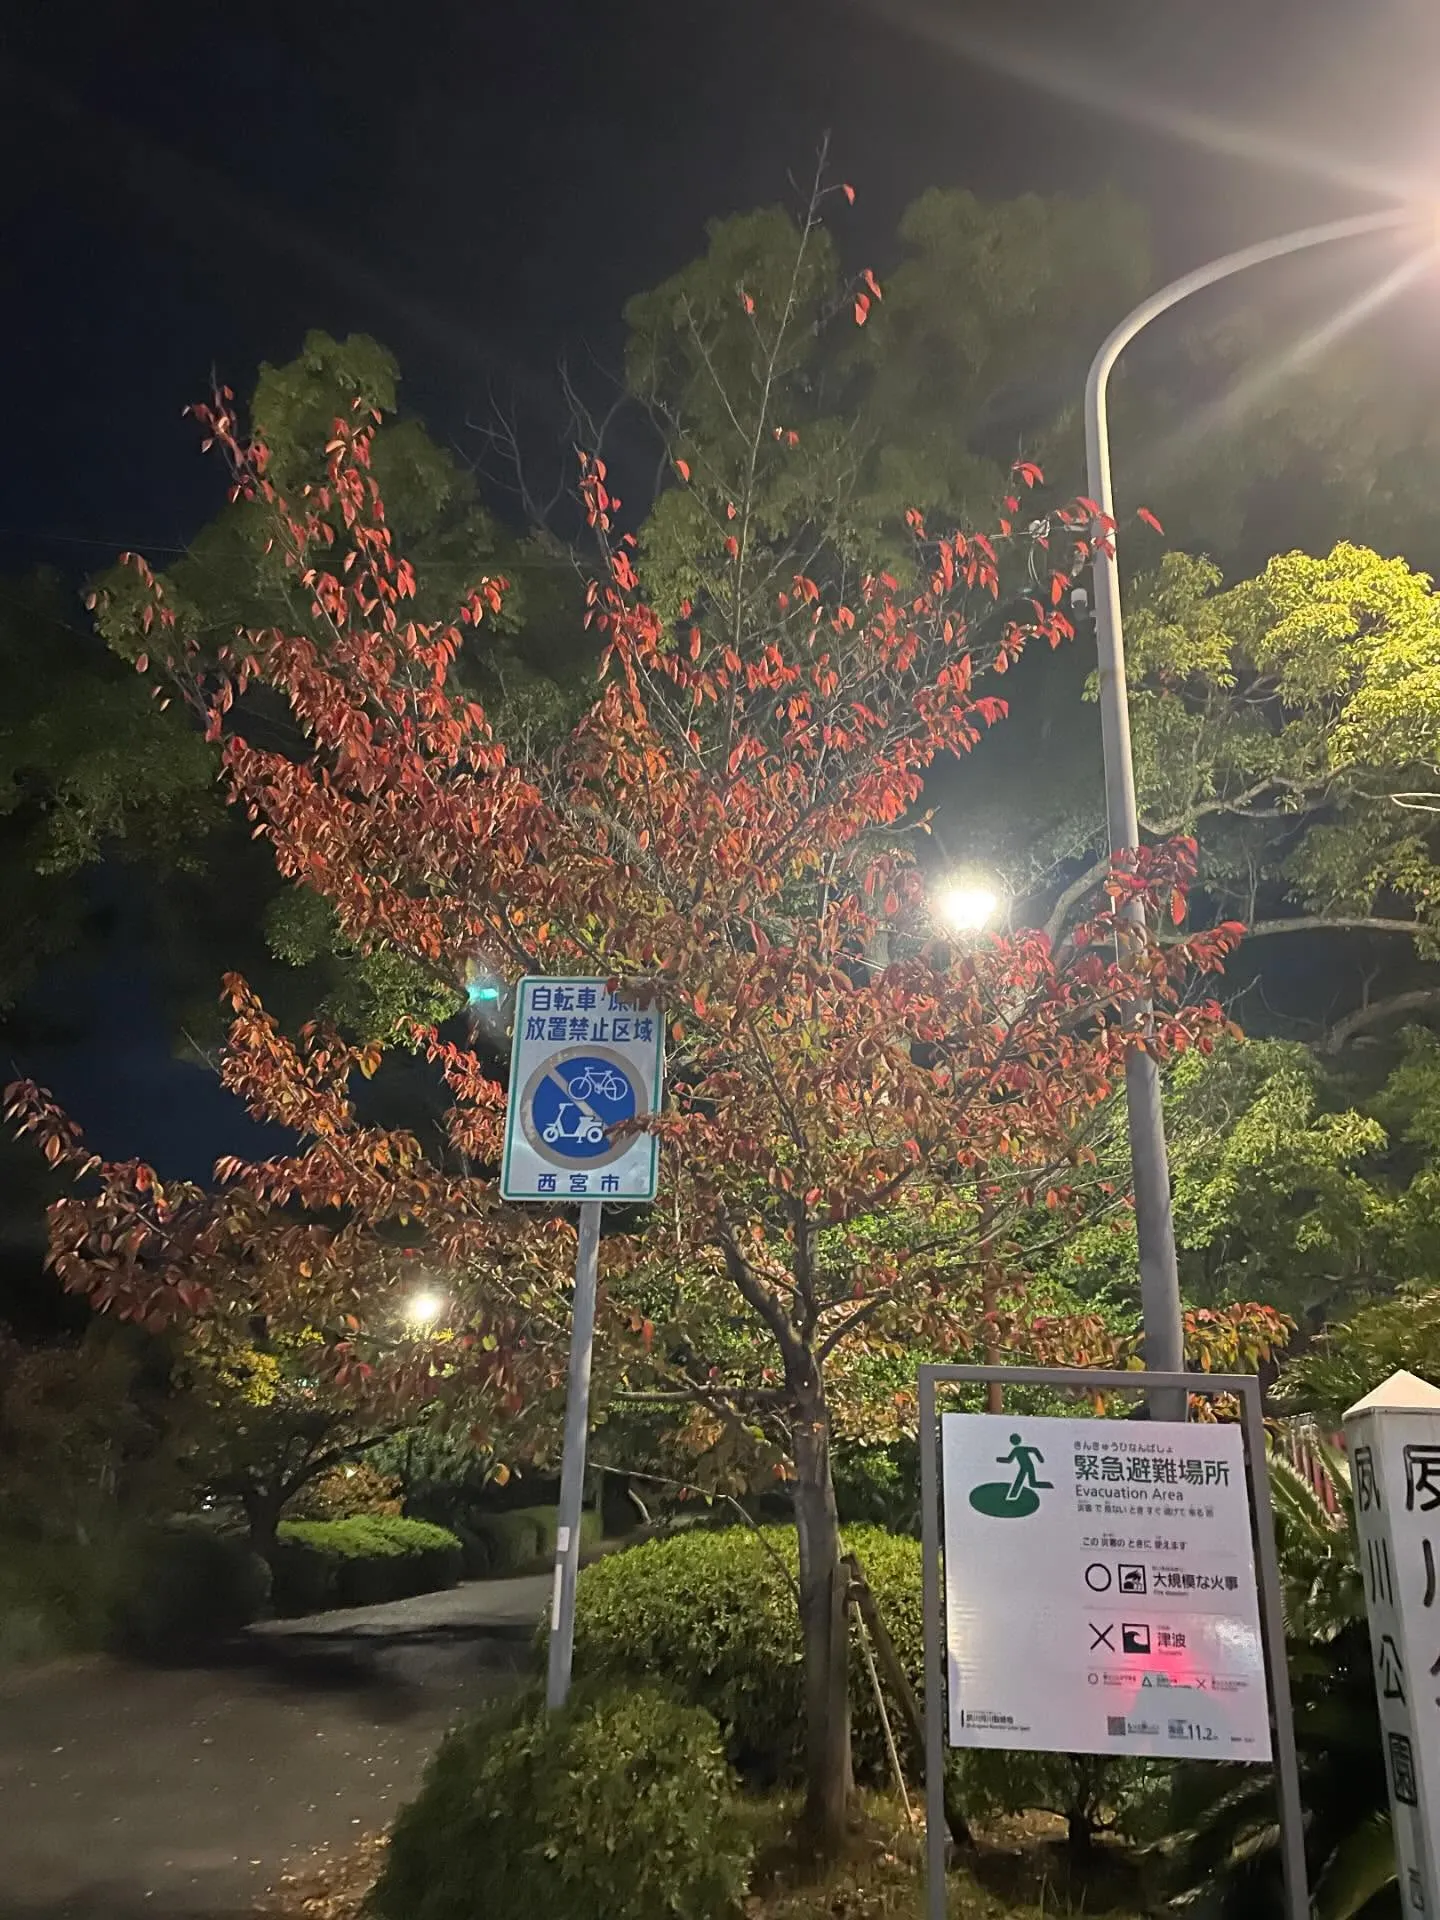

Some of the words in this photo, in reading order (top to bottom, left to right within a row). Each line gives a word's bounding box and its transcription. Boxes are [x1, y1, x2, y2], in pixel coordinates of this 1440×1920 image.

[525, 1016, 653, 1042] 放置禁止区域
[537, 1173, 620, 1193] 西宮市
[1074, 1454, 1230, 1487] 緊急避難場所
[1075, 1484, 1148, 1500] Evacuation
[1152, 1487, 1184, 1502] Area
[1153, 1573, 1239, 1591] 大規模な火事
[1157, 1631, 1187, 1649] 津波
